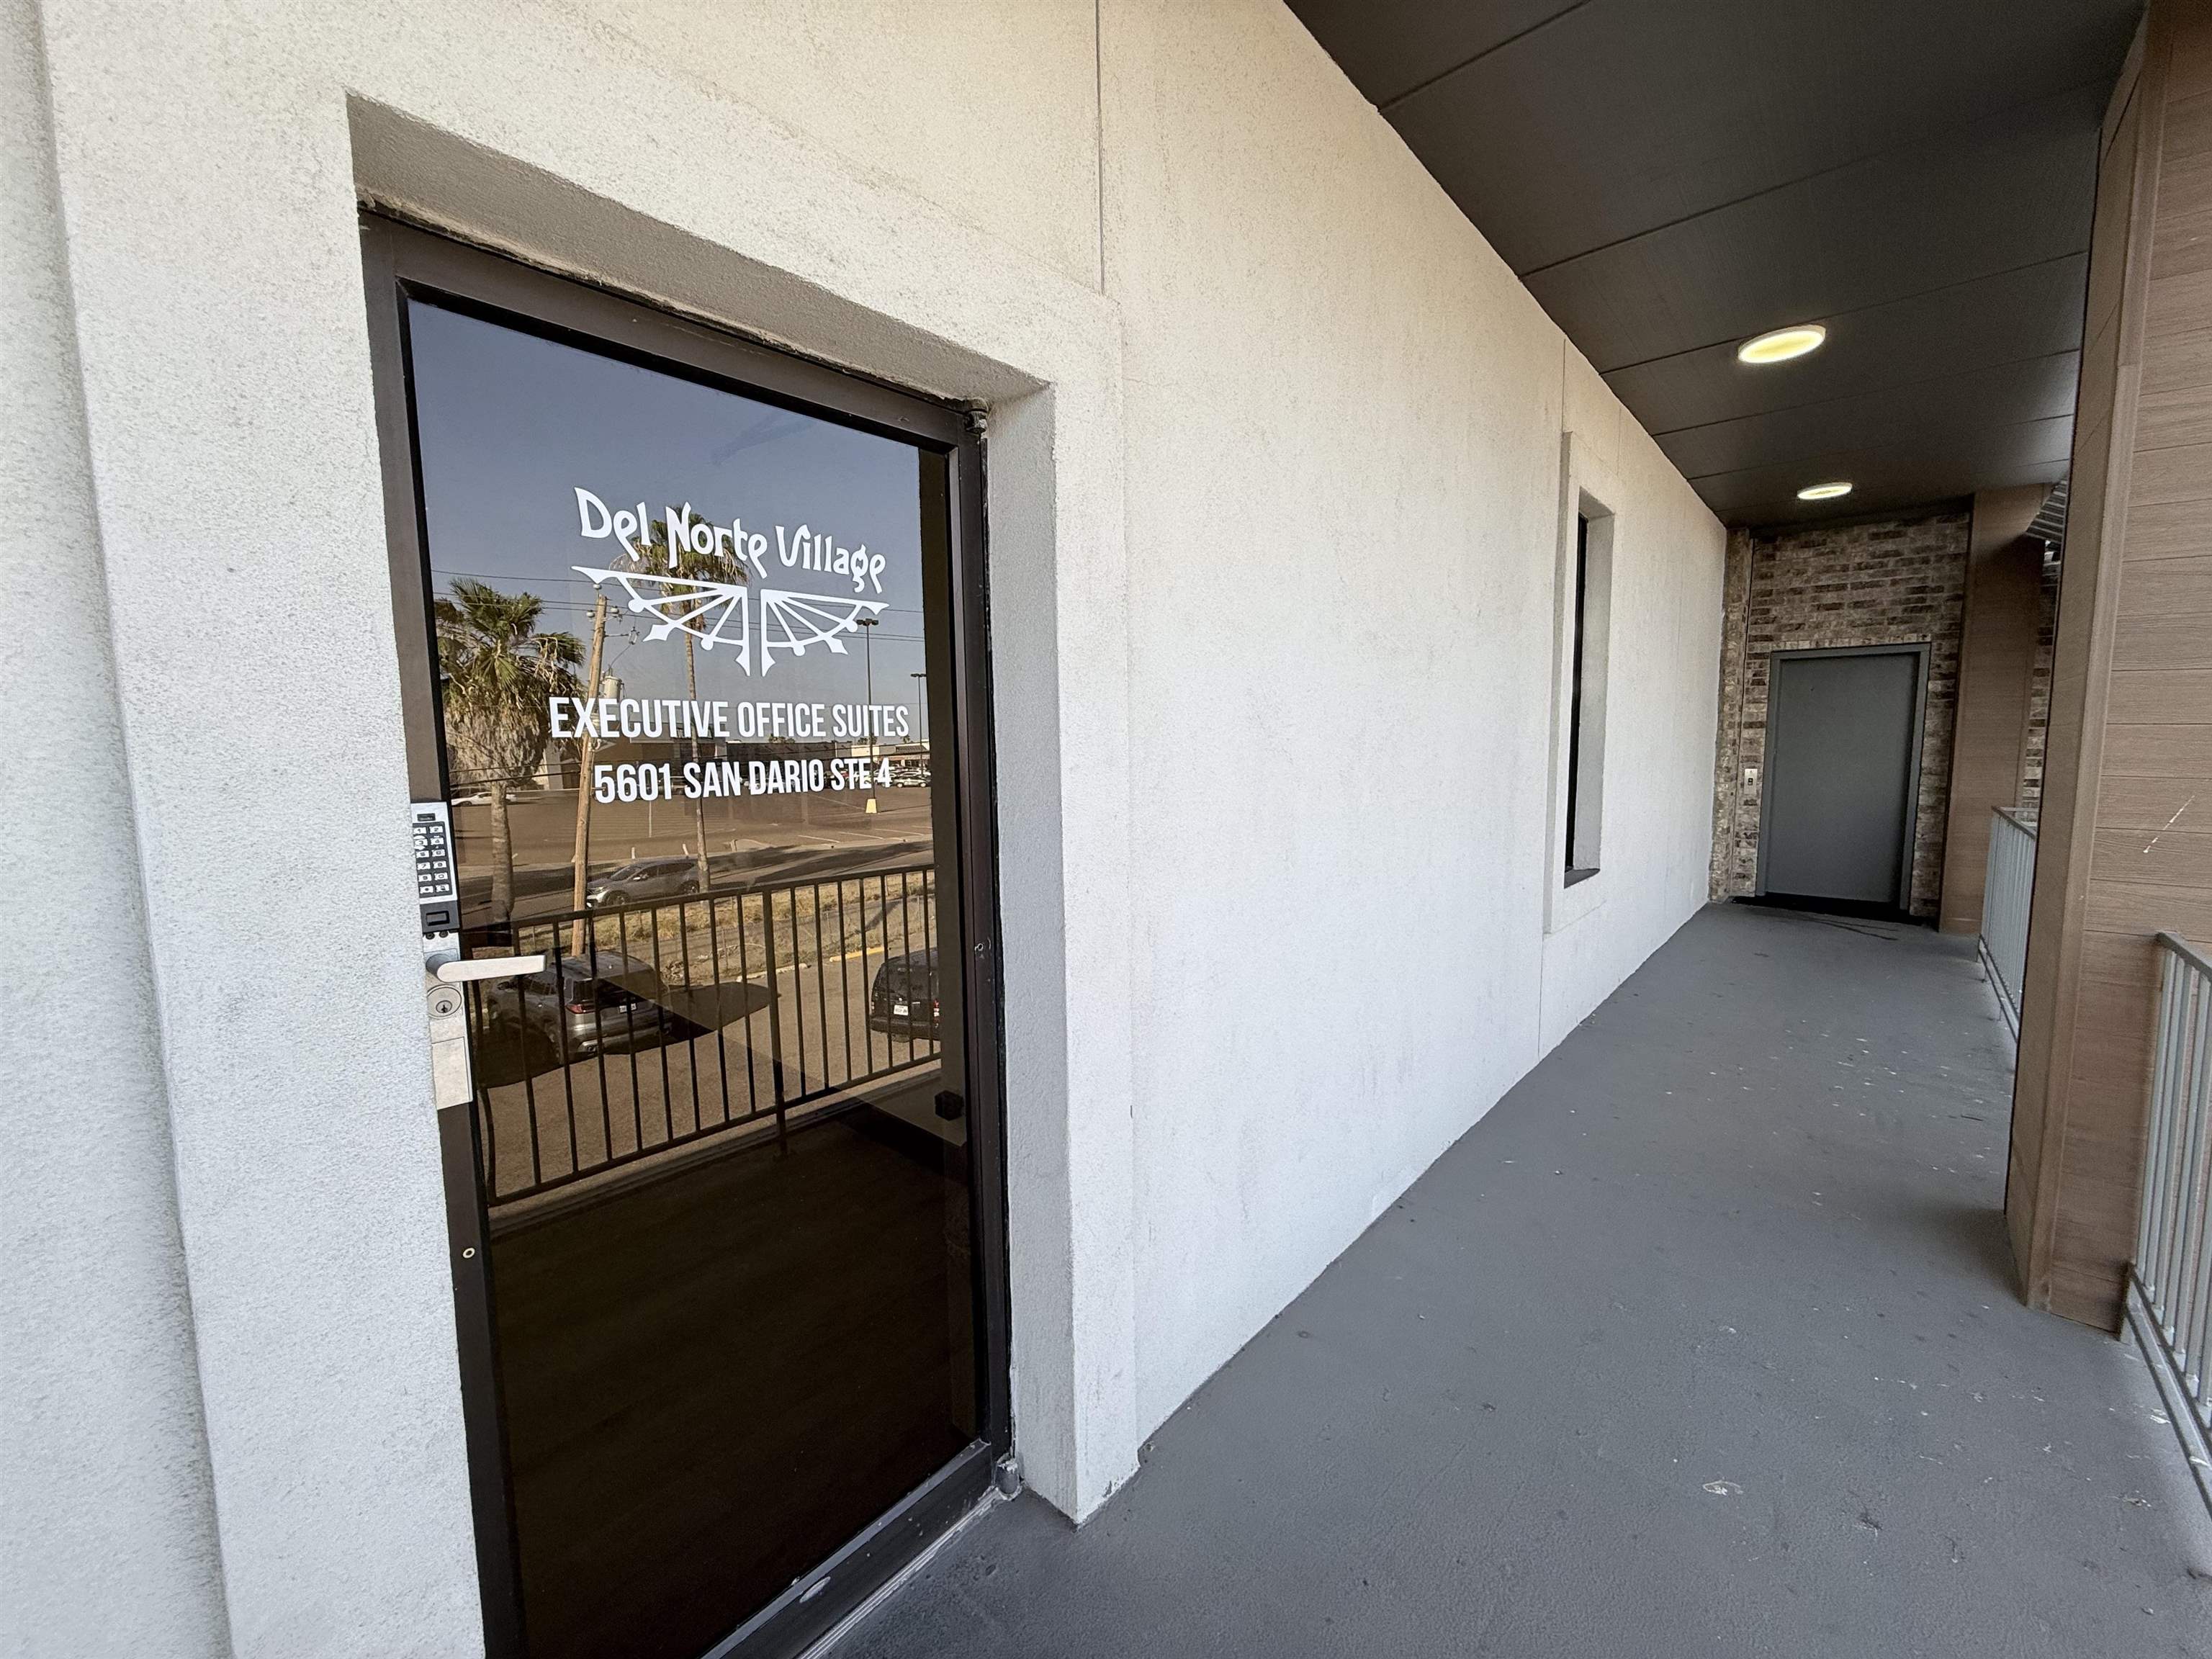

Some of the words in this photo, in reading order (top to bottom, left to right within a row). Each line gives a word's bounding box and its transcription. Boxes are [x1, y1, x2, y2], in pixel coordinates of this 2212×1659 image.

[574, 487, 652, 562] Del
[665, 501, 768, 580] Norte
[775, 523, 886, 594] Village
[549, 696, 730, 739] EXECUTIVE
[737, 701, 827, 738] OFFICE
[832, 703, 910, 738] SUITES
[594, 763, 672, 804] 5601
[683, 761, 743, 799] SAN
[749, 759, 824, 794] DARIO
[830, 757, 871, 791] STE
[878, 757, 892, 788] 4
